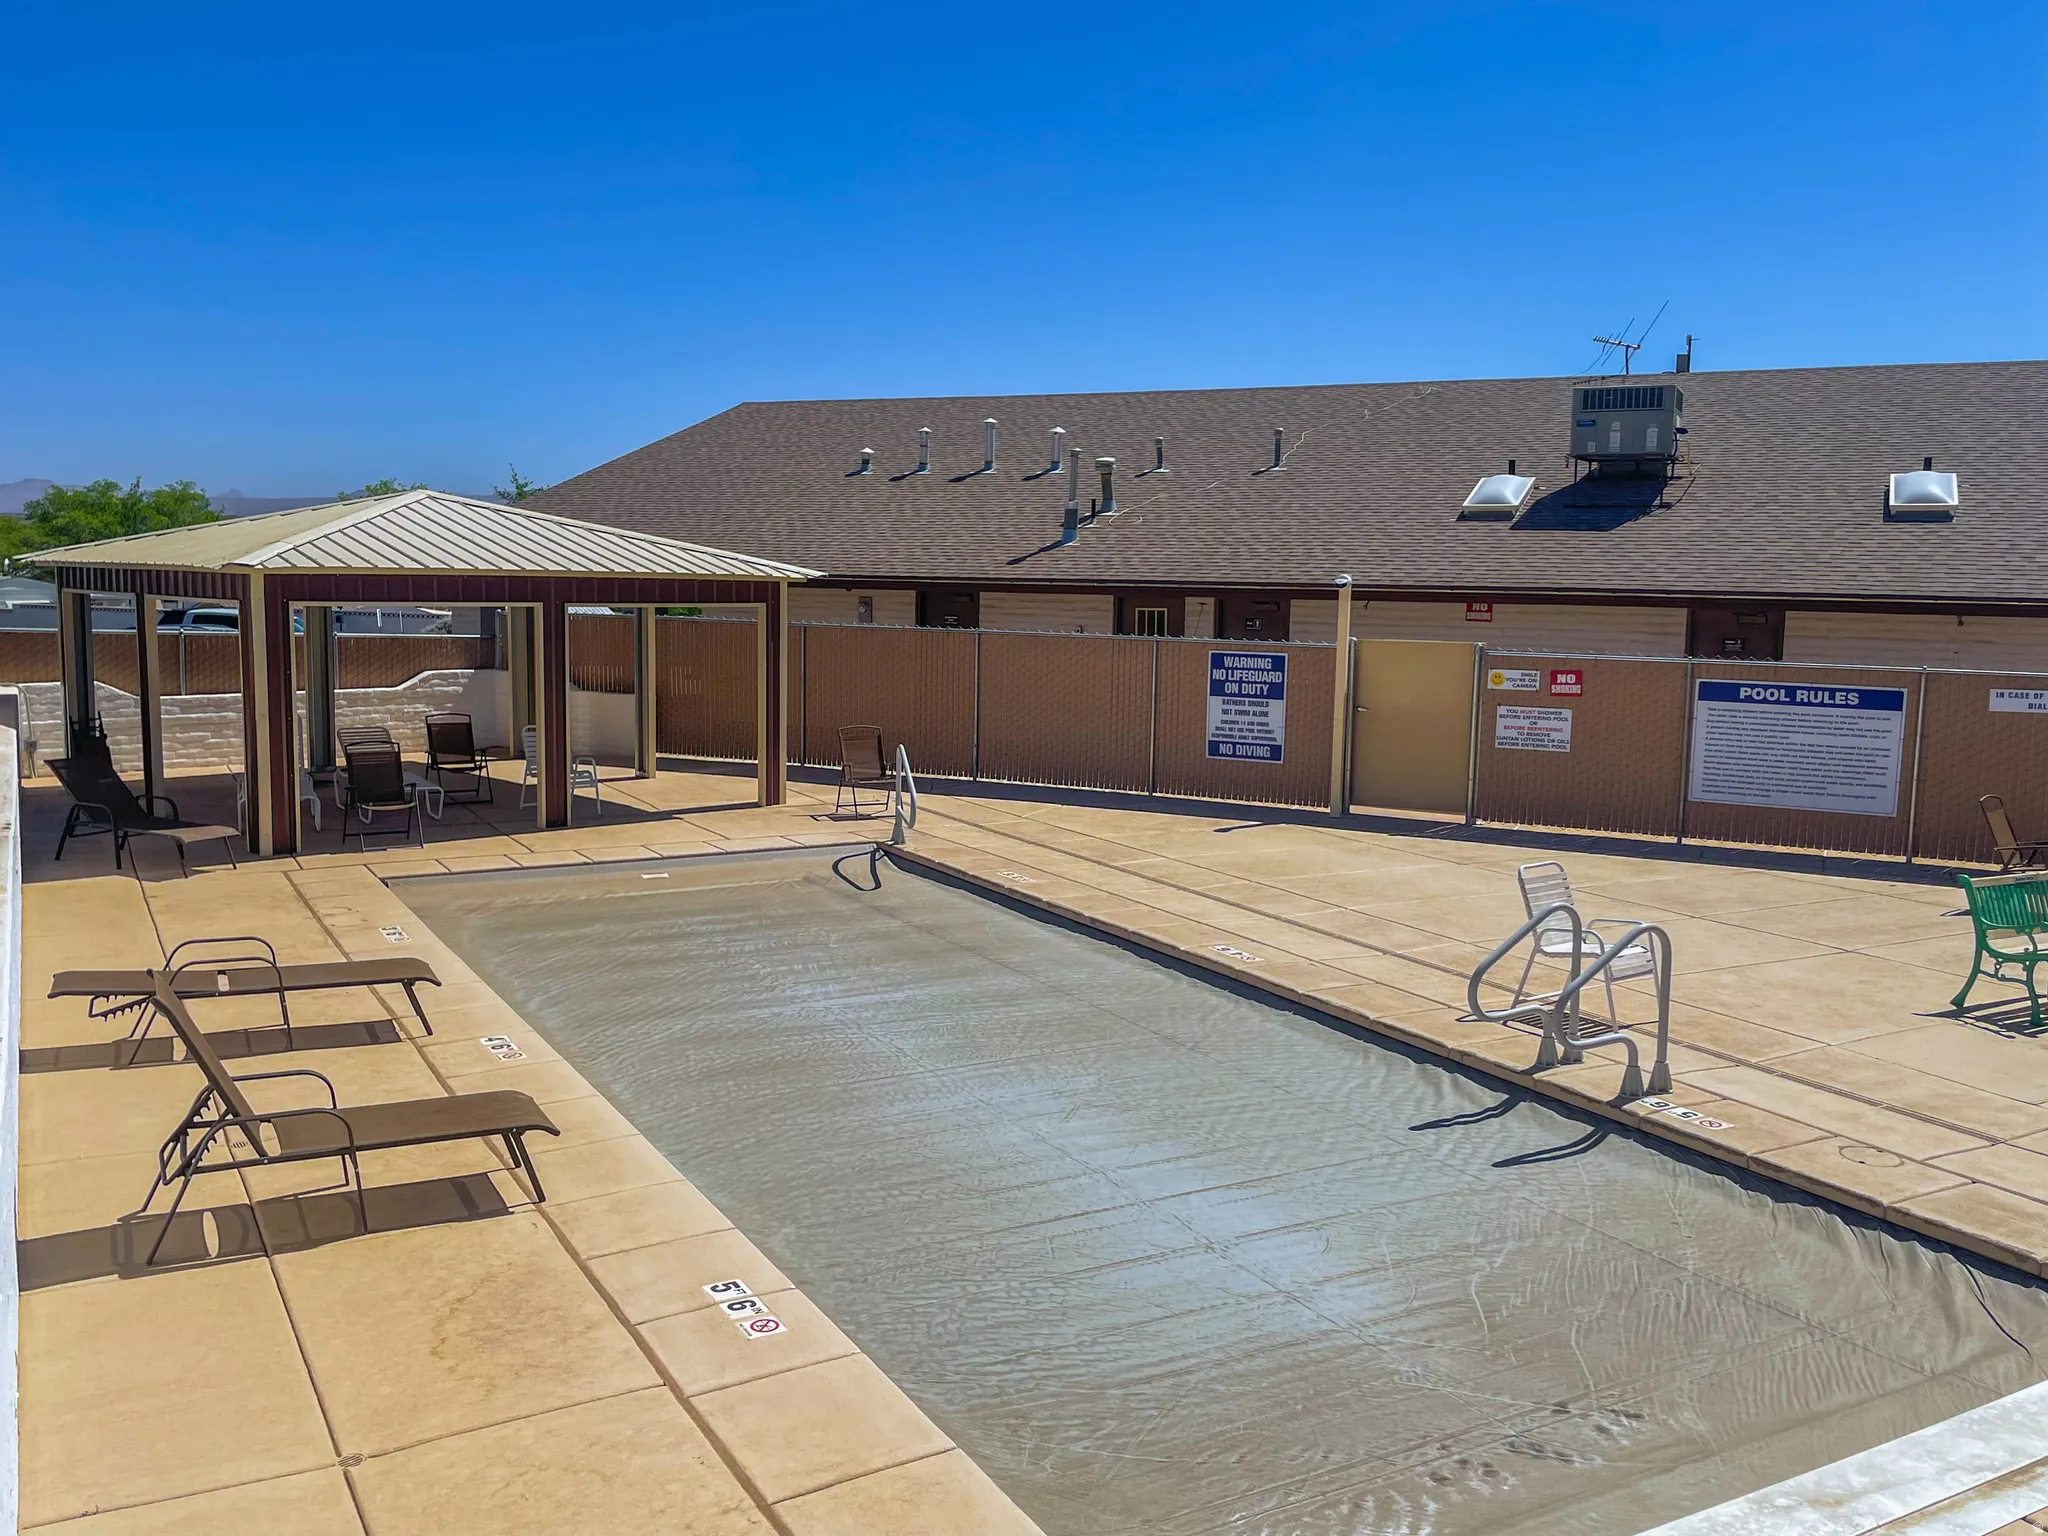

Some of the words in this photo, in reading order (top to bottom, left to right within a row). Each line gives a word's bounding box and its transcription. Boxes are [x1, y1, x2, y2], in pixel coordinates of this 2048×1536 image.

[1472, 603, 1488, 611] NO
[1467, 612, 1491, 620] SMOKING
[1224, 656, 1272, 669] WARNING
[1212, 669, 1226, 680] NO
[1228, 670, 1282, 682] LIFEGUARD
[1557, 674, 1576, 683] NO
[1225, 682, 1239, 694] ON
[1242, 683, 1269, 695] DUTY
[1551, 685, 1581, 693] SMOKING
[1740, 687, 1790, 701] POOL
[1796, 690, 1859, 705] RULES
[1219, 743, 1233, 754] NO
[1236, 744, 1270, 757] DIVING
[710, 1281, 741, 1293] 5
[727, 1299, 757, 1312] 6
